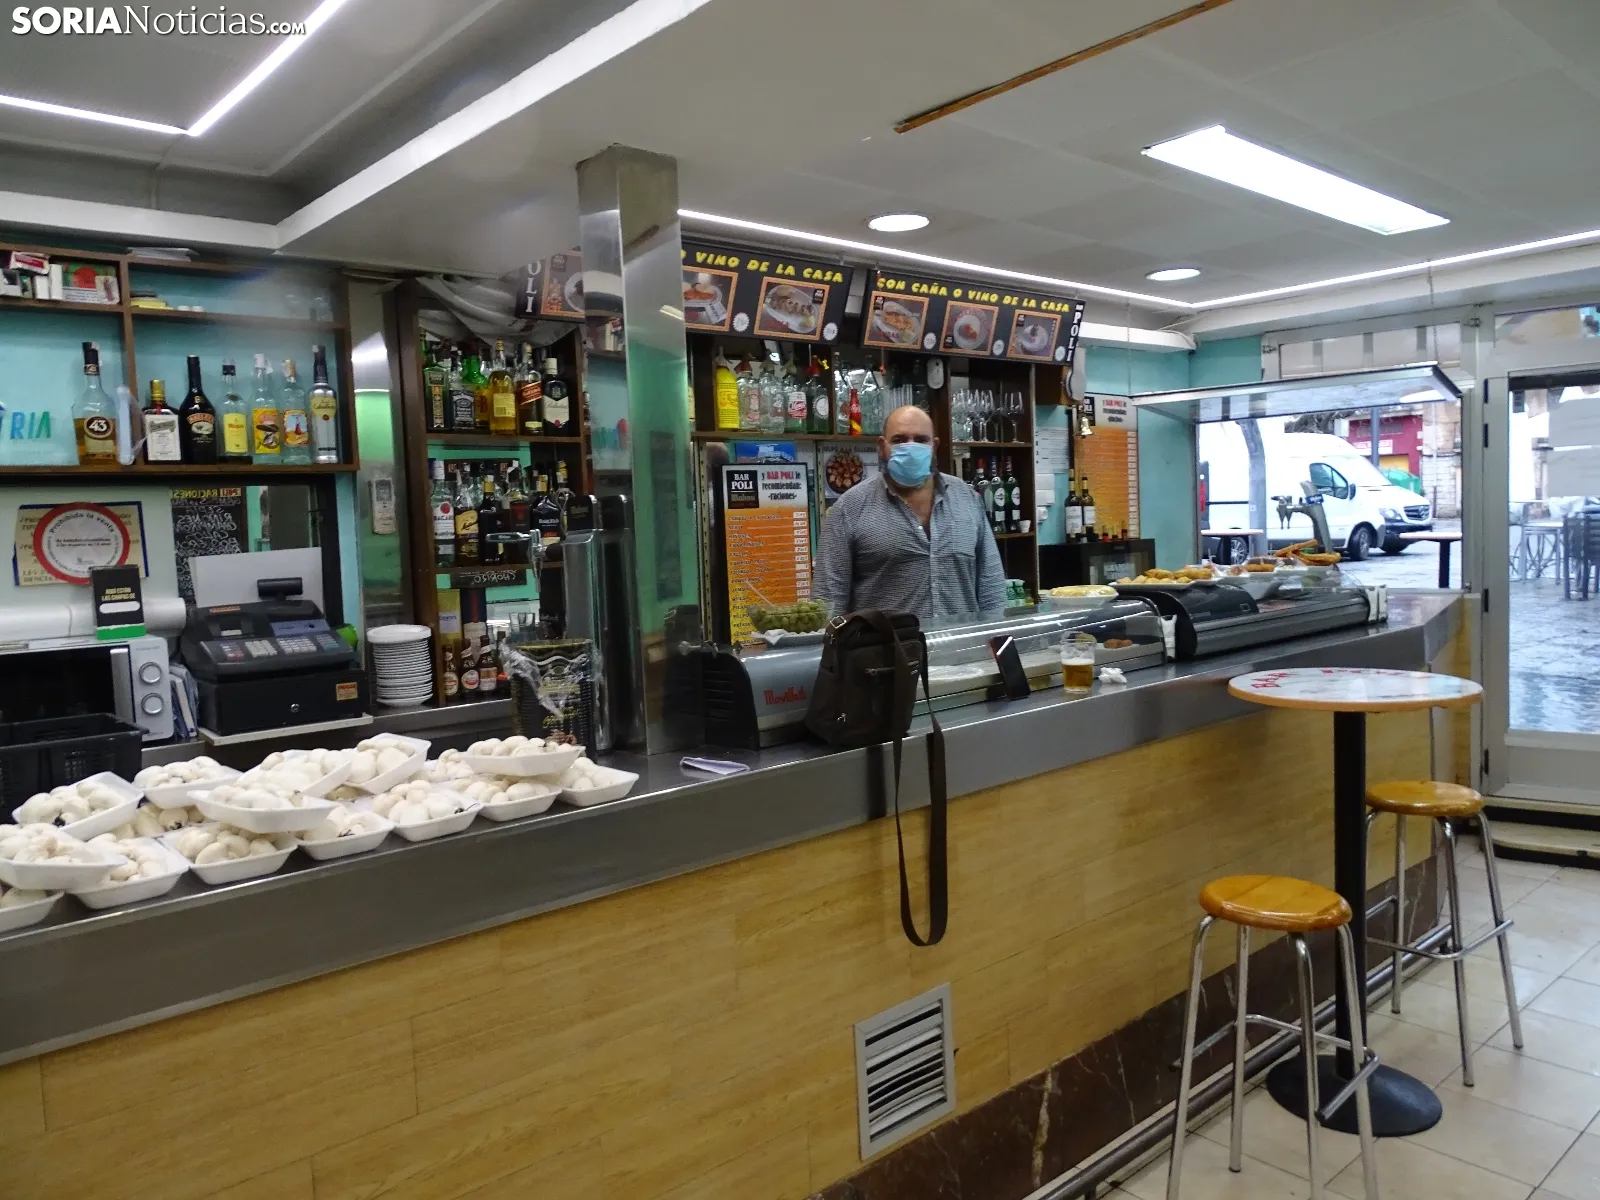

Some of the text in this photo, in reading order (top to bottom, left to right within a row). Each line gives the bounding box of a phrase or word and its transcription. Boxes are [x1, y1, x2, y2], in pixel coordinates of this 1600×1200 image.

[696, 251, 740, 268] VINO
[746, 260, 770, 272] DE
[776, 264, 796, 276] LA
[802, 268, 844, 283] CASA
[876, 278, 1070, 312] CON CAÑA O VINO DE LA CASA
[88, 420, 108, 432] 43
[731, 481, 753, 490] POLI
